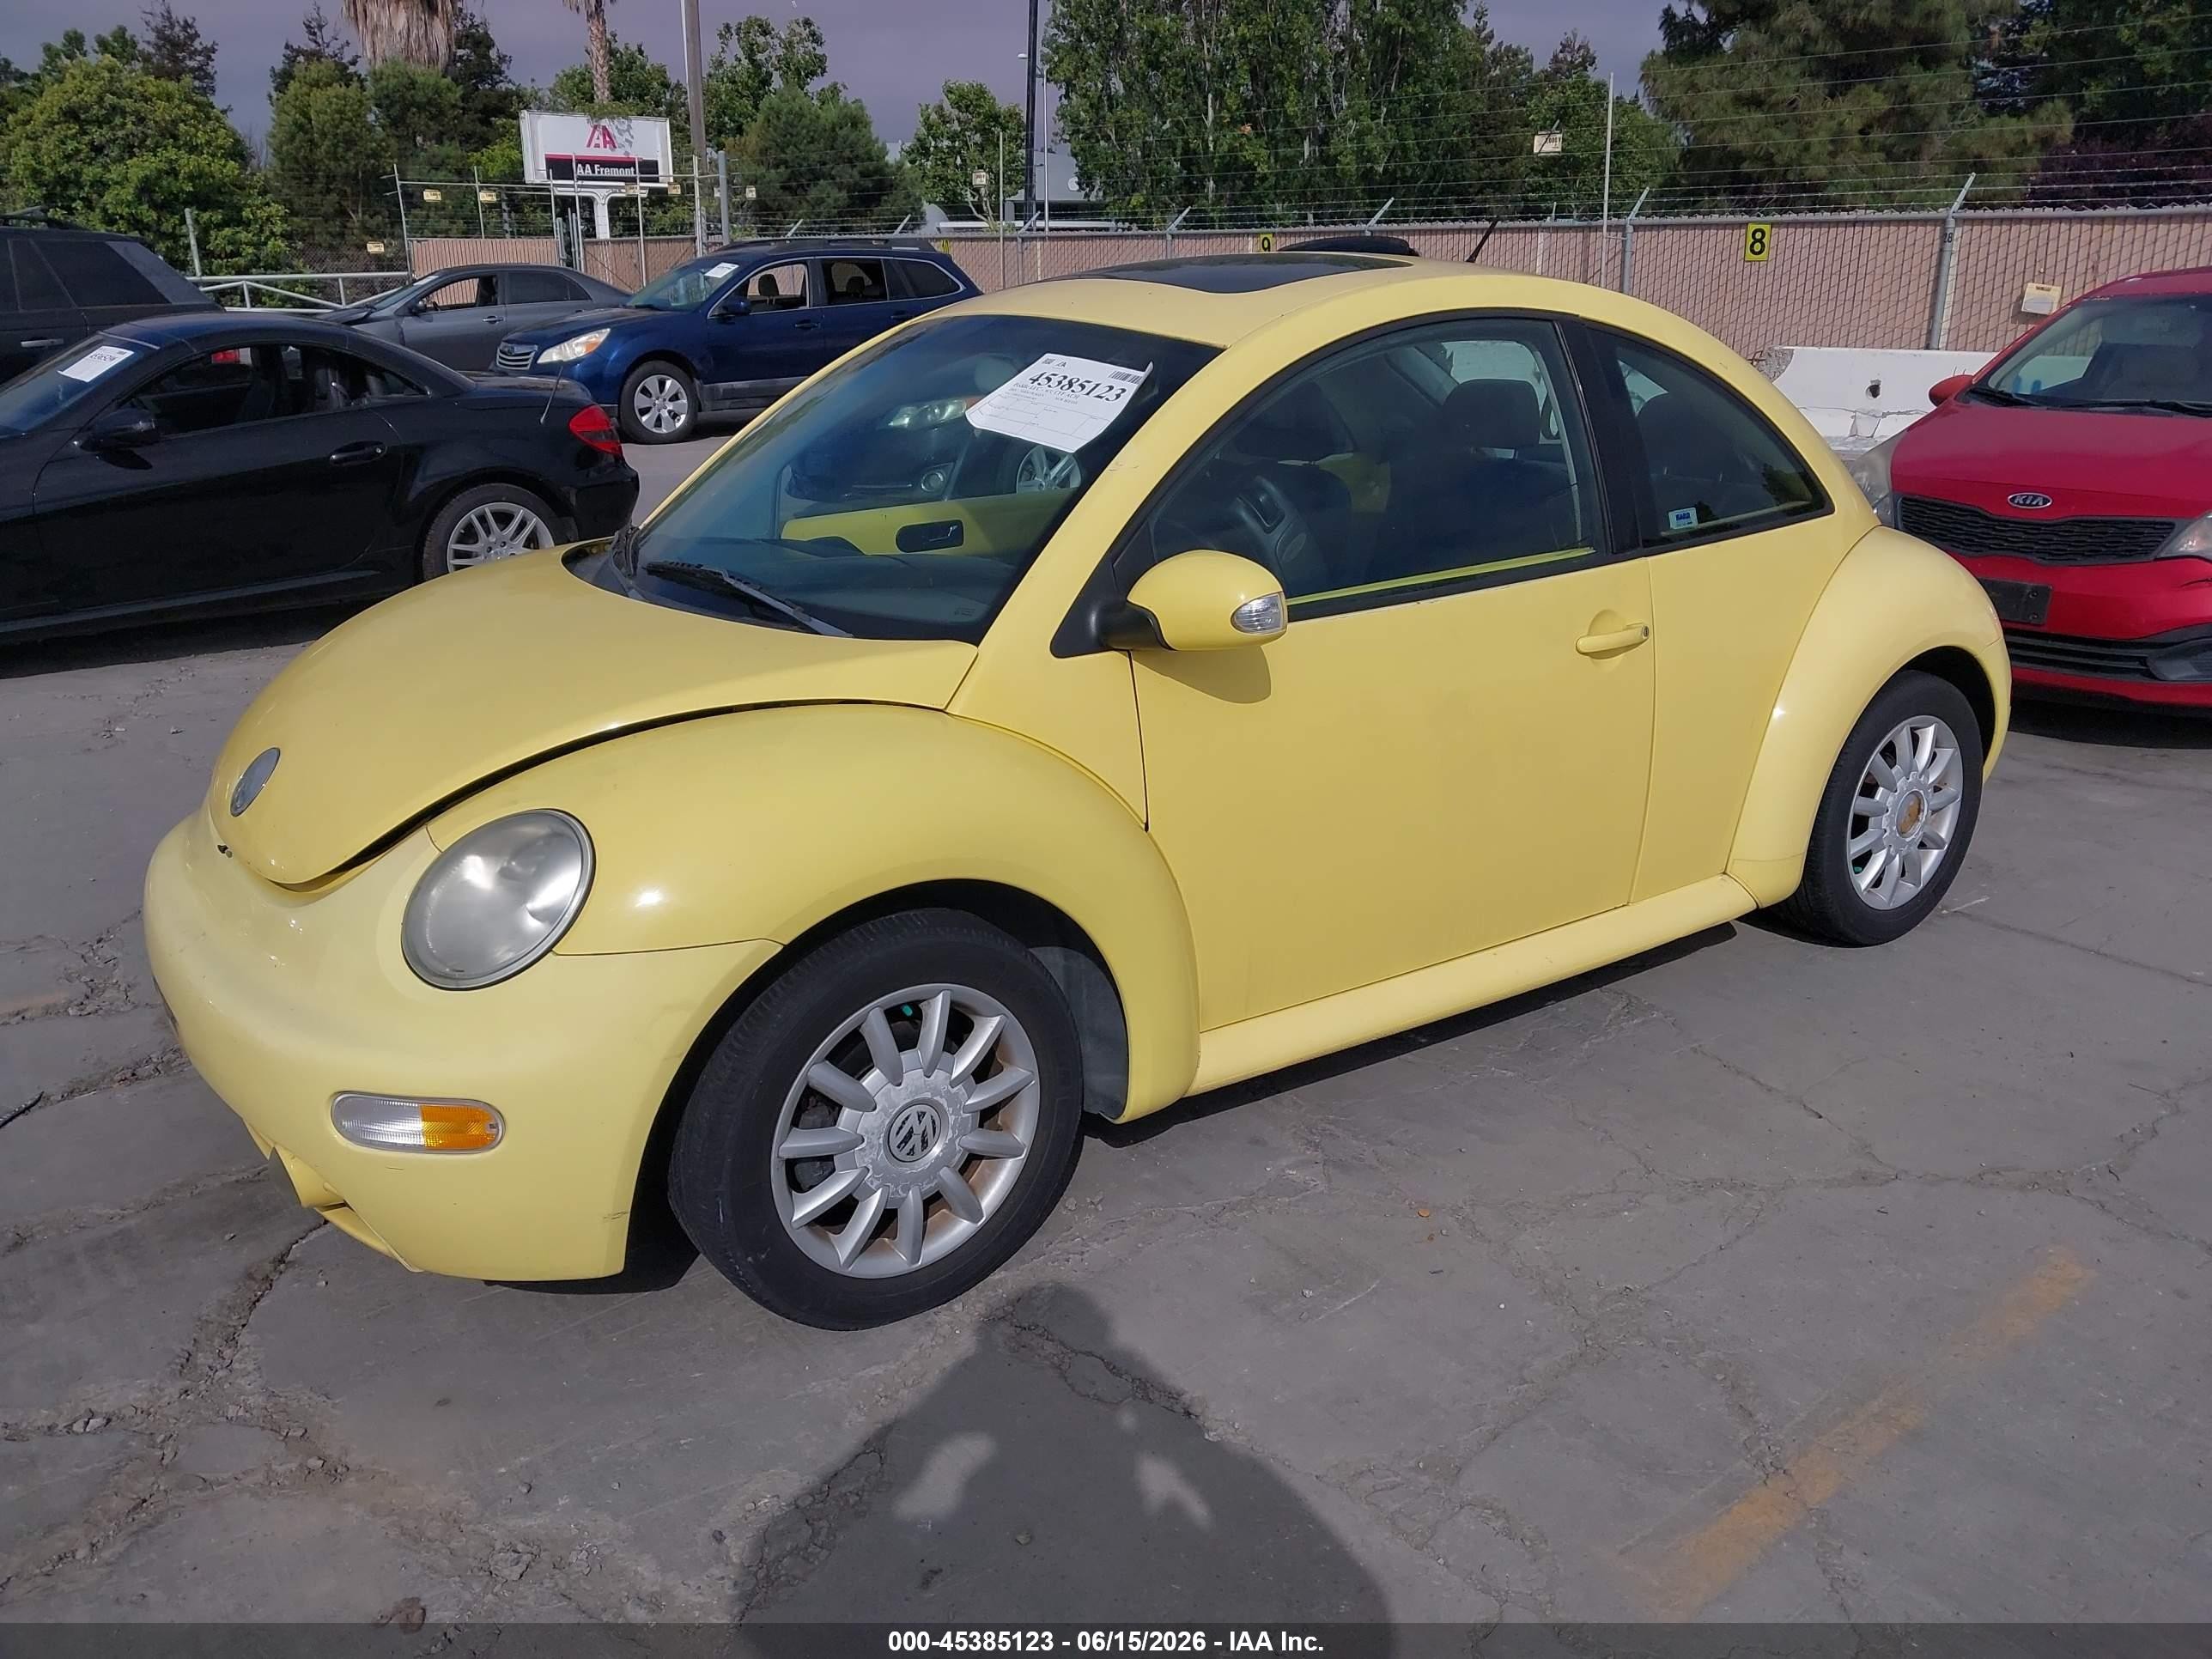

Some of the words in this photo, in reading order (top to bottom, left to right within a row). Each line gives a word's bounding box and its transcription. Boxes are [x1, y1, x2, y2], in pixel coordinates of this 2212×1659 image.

[594, 164, 635, 177] Fremont
[1261, 236, 1271, 252] 9
[1749, 228, 1766, 256] 8
[1028, 371, 1127, 403] 45385123
[2014, 495, 2044, 506] KIA
